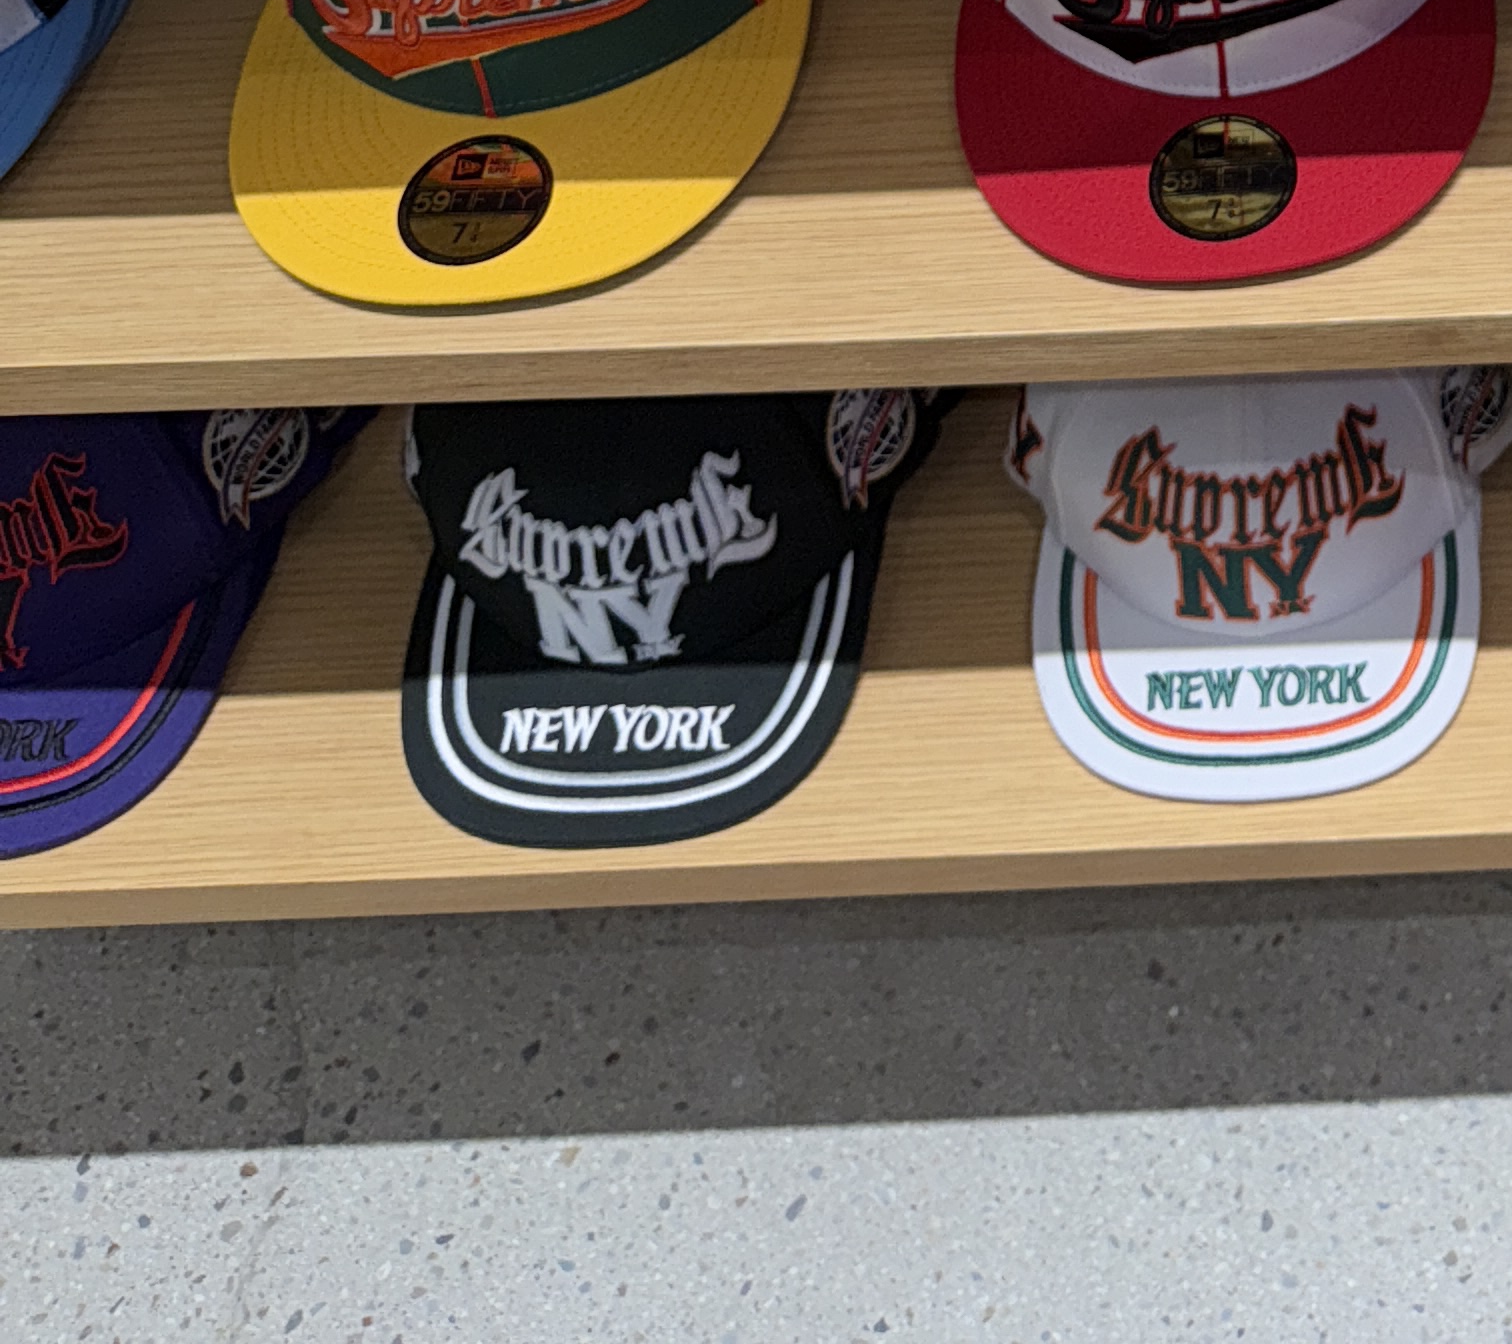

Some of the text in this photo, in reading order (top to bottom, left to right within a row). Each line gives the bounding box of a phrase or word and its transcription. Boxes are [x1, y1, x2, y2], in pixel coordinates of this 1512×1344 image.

[1170, 525, 1330, 623] NY
[524, 566, 690, 664] NY
[1146, 661, 1370, 712] NEW YORK
[501, 704, 736, 753] NEW YORK
